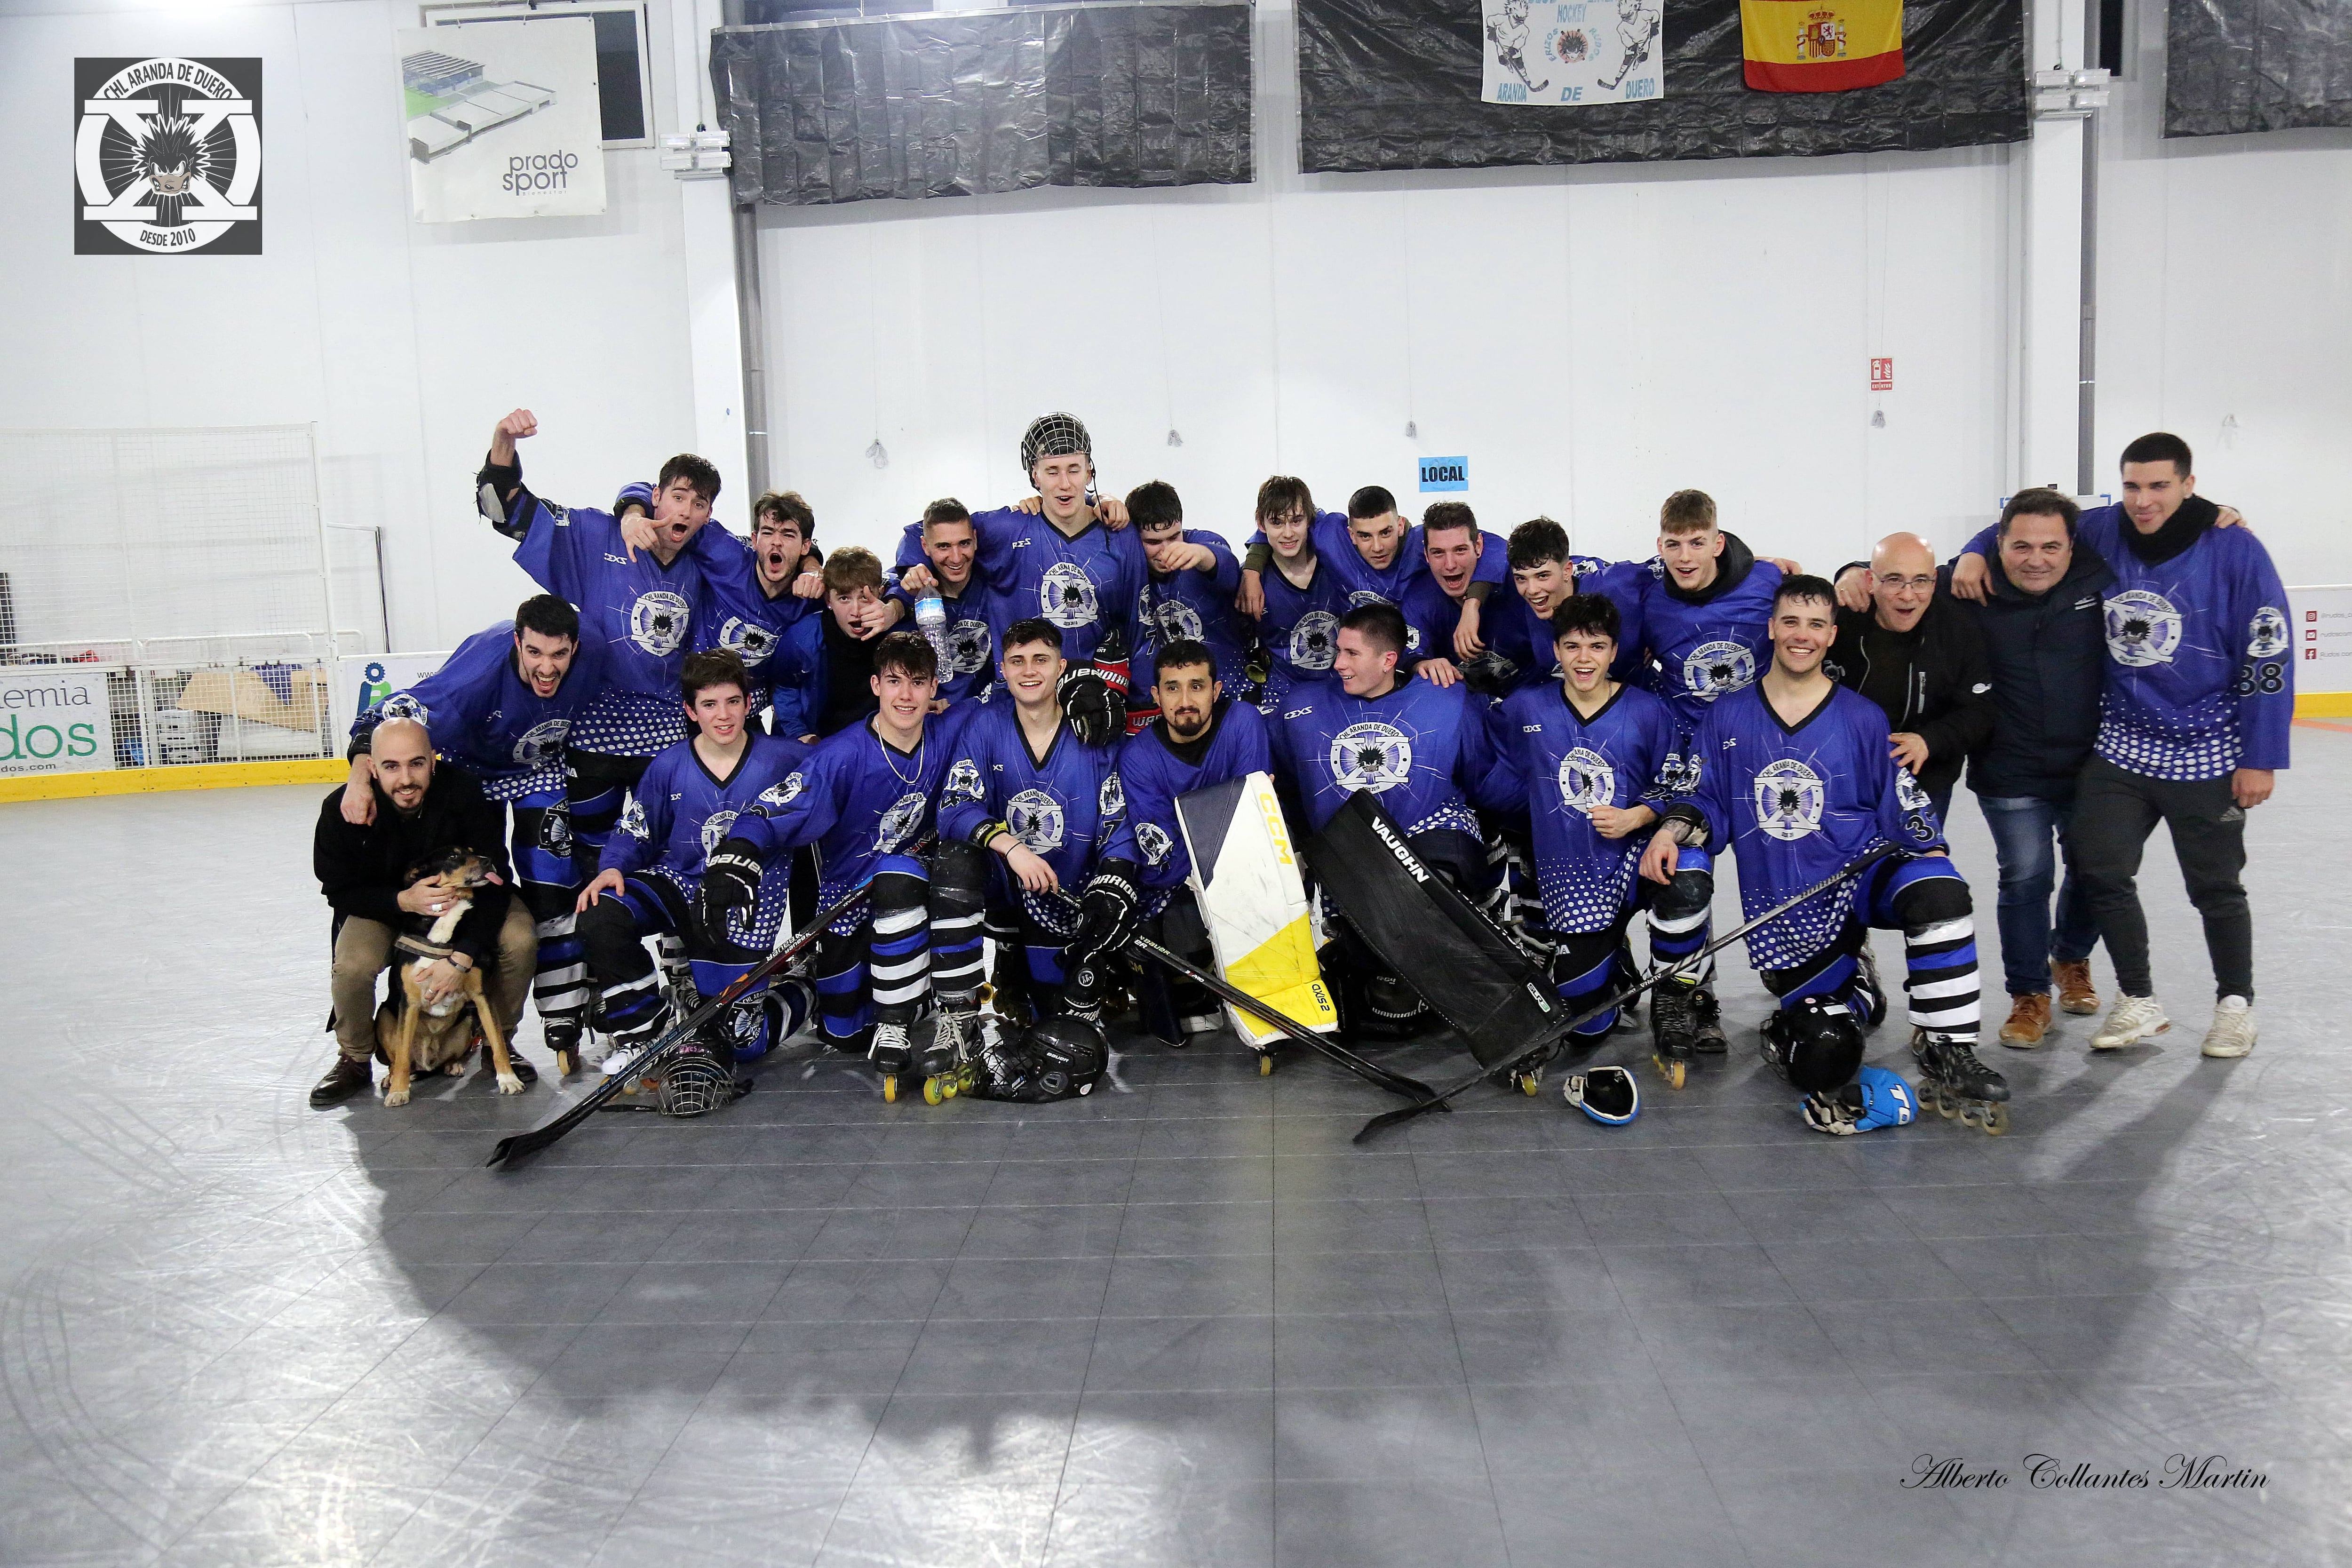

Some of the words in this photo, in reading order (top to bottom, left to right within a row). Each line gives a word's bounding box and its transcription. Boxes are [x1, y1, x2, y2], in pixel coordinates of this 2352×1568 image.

[1557, 4, 1587, 23] HOCKEY
[1545, 28, 1559, 62] ERIZOS
[1497, 83, 1527, 102] ARANDA
[1560, 87, 1583, 101] DE
[1626, 78, 1655, 99] DUERO
[509, 150, 578, 175] prado
[502, 166, 567, 196] sport
[1422, 466, 1464, 482] LOCAL
[1698, 644, 1716, 656] ARANDA
[1724, 643, 1741, 651] DUERO
[2239, 662, 2285, 697] 88
[0, 680, 91, 708] emia
[536, 722, 553, 733] ARANDA
[1350, 724, 1372, 735] ARANDA
[1381, 726, 1399, 737] DUERO
[1590, 754, 1605, 767] DUERO
[1790, 762, 1797, 770] DE
[1798, 765, 1814, 779] DUERO
[1259, 793, 1293, 865] CCM
[1371, 816, 1430, 883] VAUGHN
[765, 936, 797, 962] BAUER
[784, 936, 807, 954] BAUER
[1144, 938, 1171, 955] BAUER
[1640, 973, 1662, 987] ALPHA
[1372, 1007, 1417, 1018] WARRIOR
[1046, 1052, 1069, 1063] BAUER
